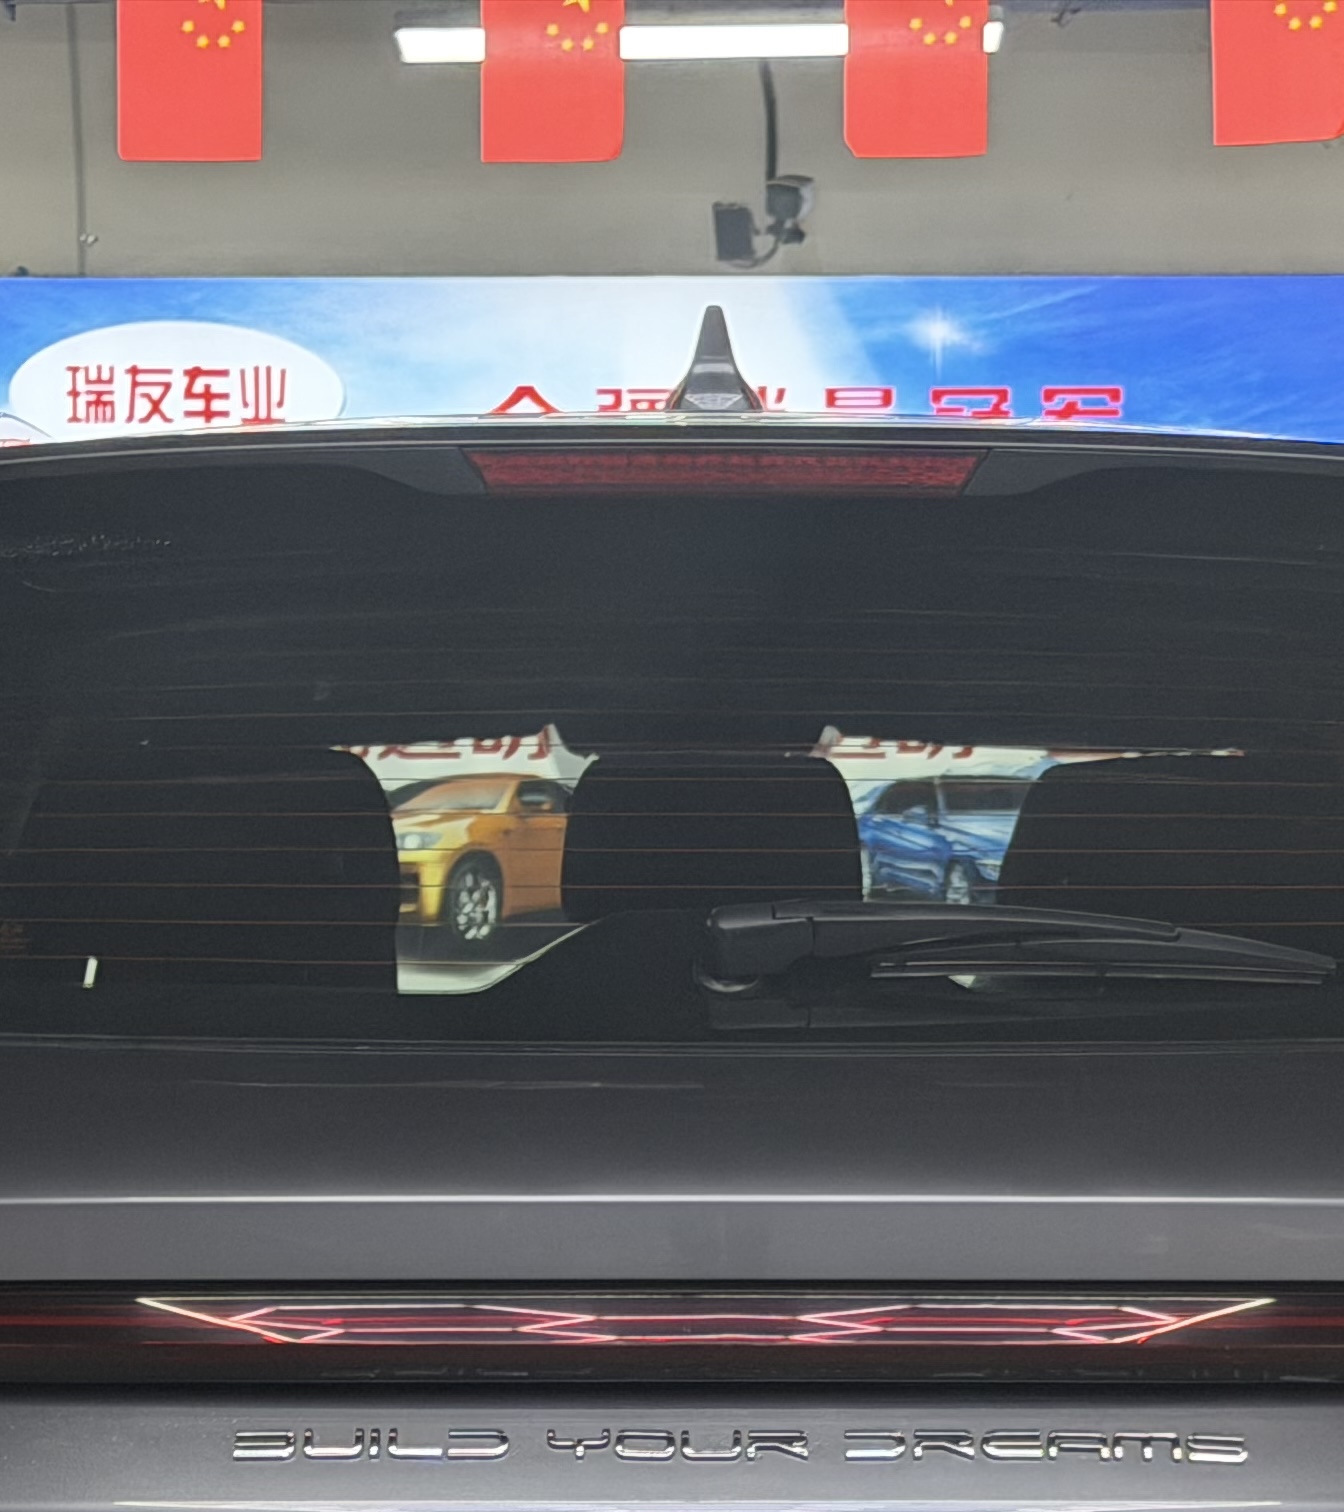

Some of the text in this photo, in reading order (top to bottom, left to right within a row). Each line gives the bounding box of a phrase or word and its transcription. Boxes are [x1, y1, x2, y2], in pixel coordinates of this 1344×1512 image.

[65, 363, 288, 425] 瑞友车业
[232, 1428, 1248, 1462] BUILD YOUR DREAMS
